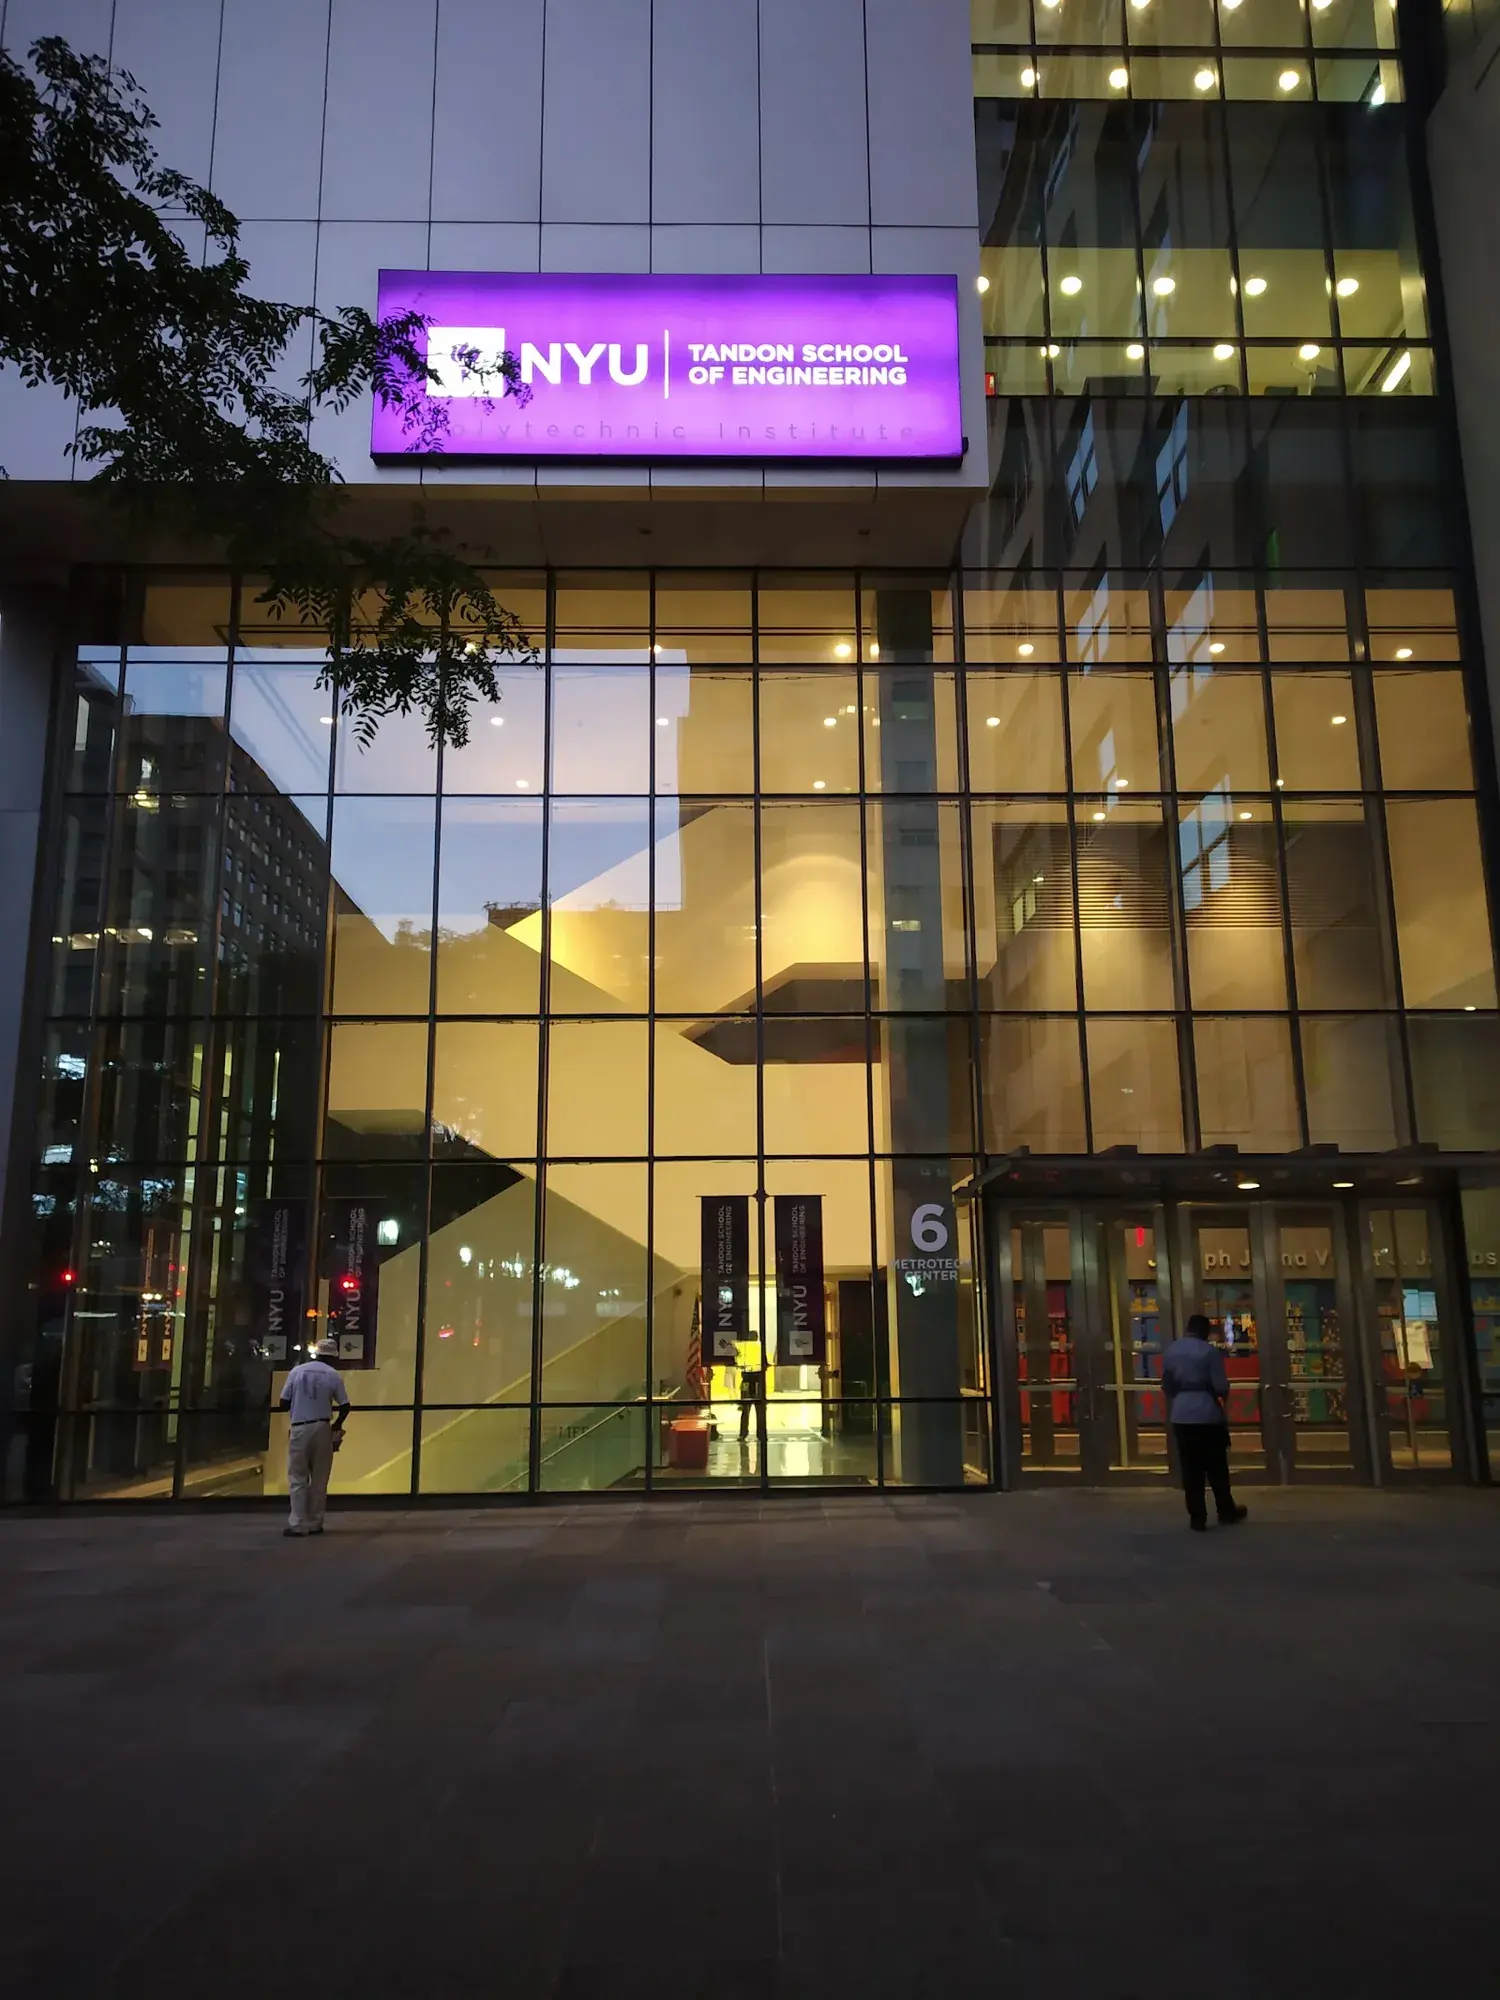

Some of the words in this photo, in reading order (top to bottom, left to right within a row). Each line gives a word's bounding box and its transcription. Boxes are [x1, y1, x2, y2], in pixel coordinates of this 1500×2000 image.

[521, 342, 649, 386] NYU
[688, 343, 795, 363] TANDON
[802, 343, 909, 364] SCHOOL
[688, 366, 724, 386] OF
[731, 366, 908, 387] ENGINEERING
[452, 419, 687, 442] olytechnic
[718, 419, 914, 441] Institute
[349, 1207, 357, 1241] SCHOOL
[356, 1208, 364, 1263] ENGINEERING
[910, 1203, 949, 1253] 6
[355, 1265, 362, 1278] OF
[905, 1270, 958, 1281] CENTER
[269, 1289, 285, 1331] NYU
[345, 1289, 361, 1330] NYU
[792, 1284, 807, 1326] NYU
